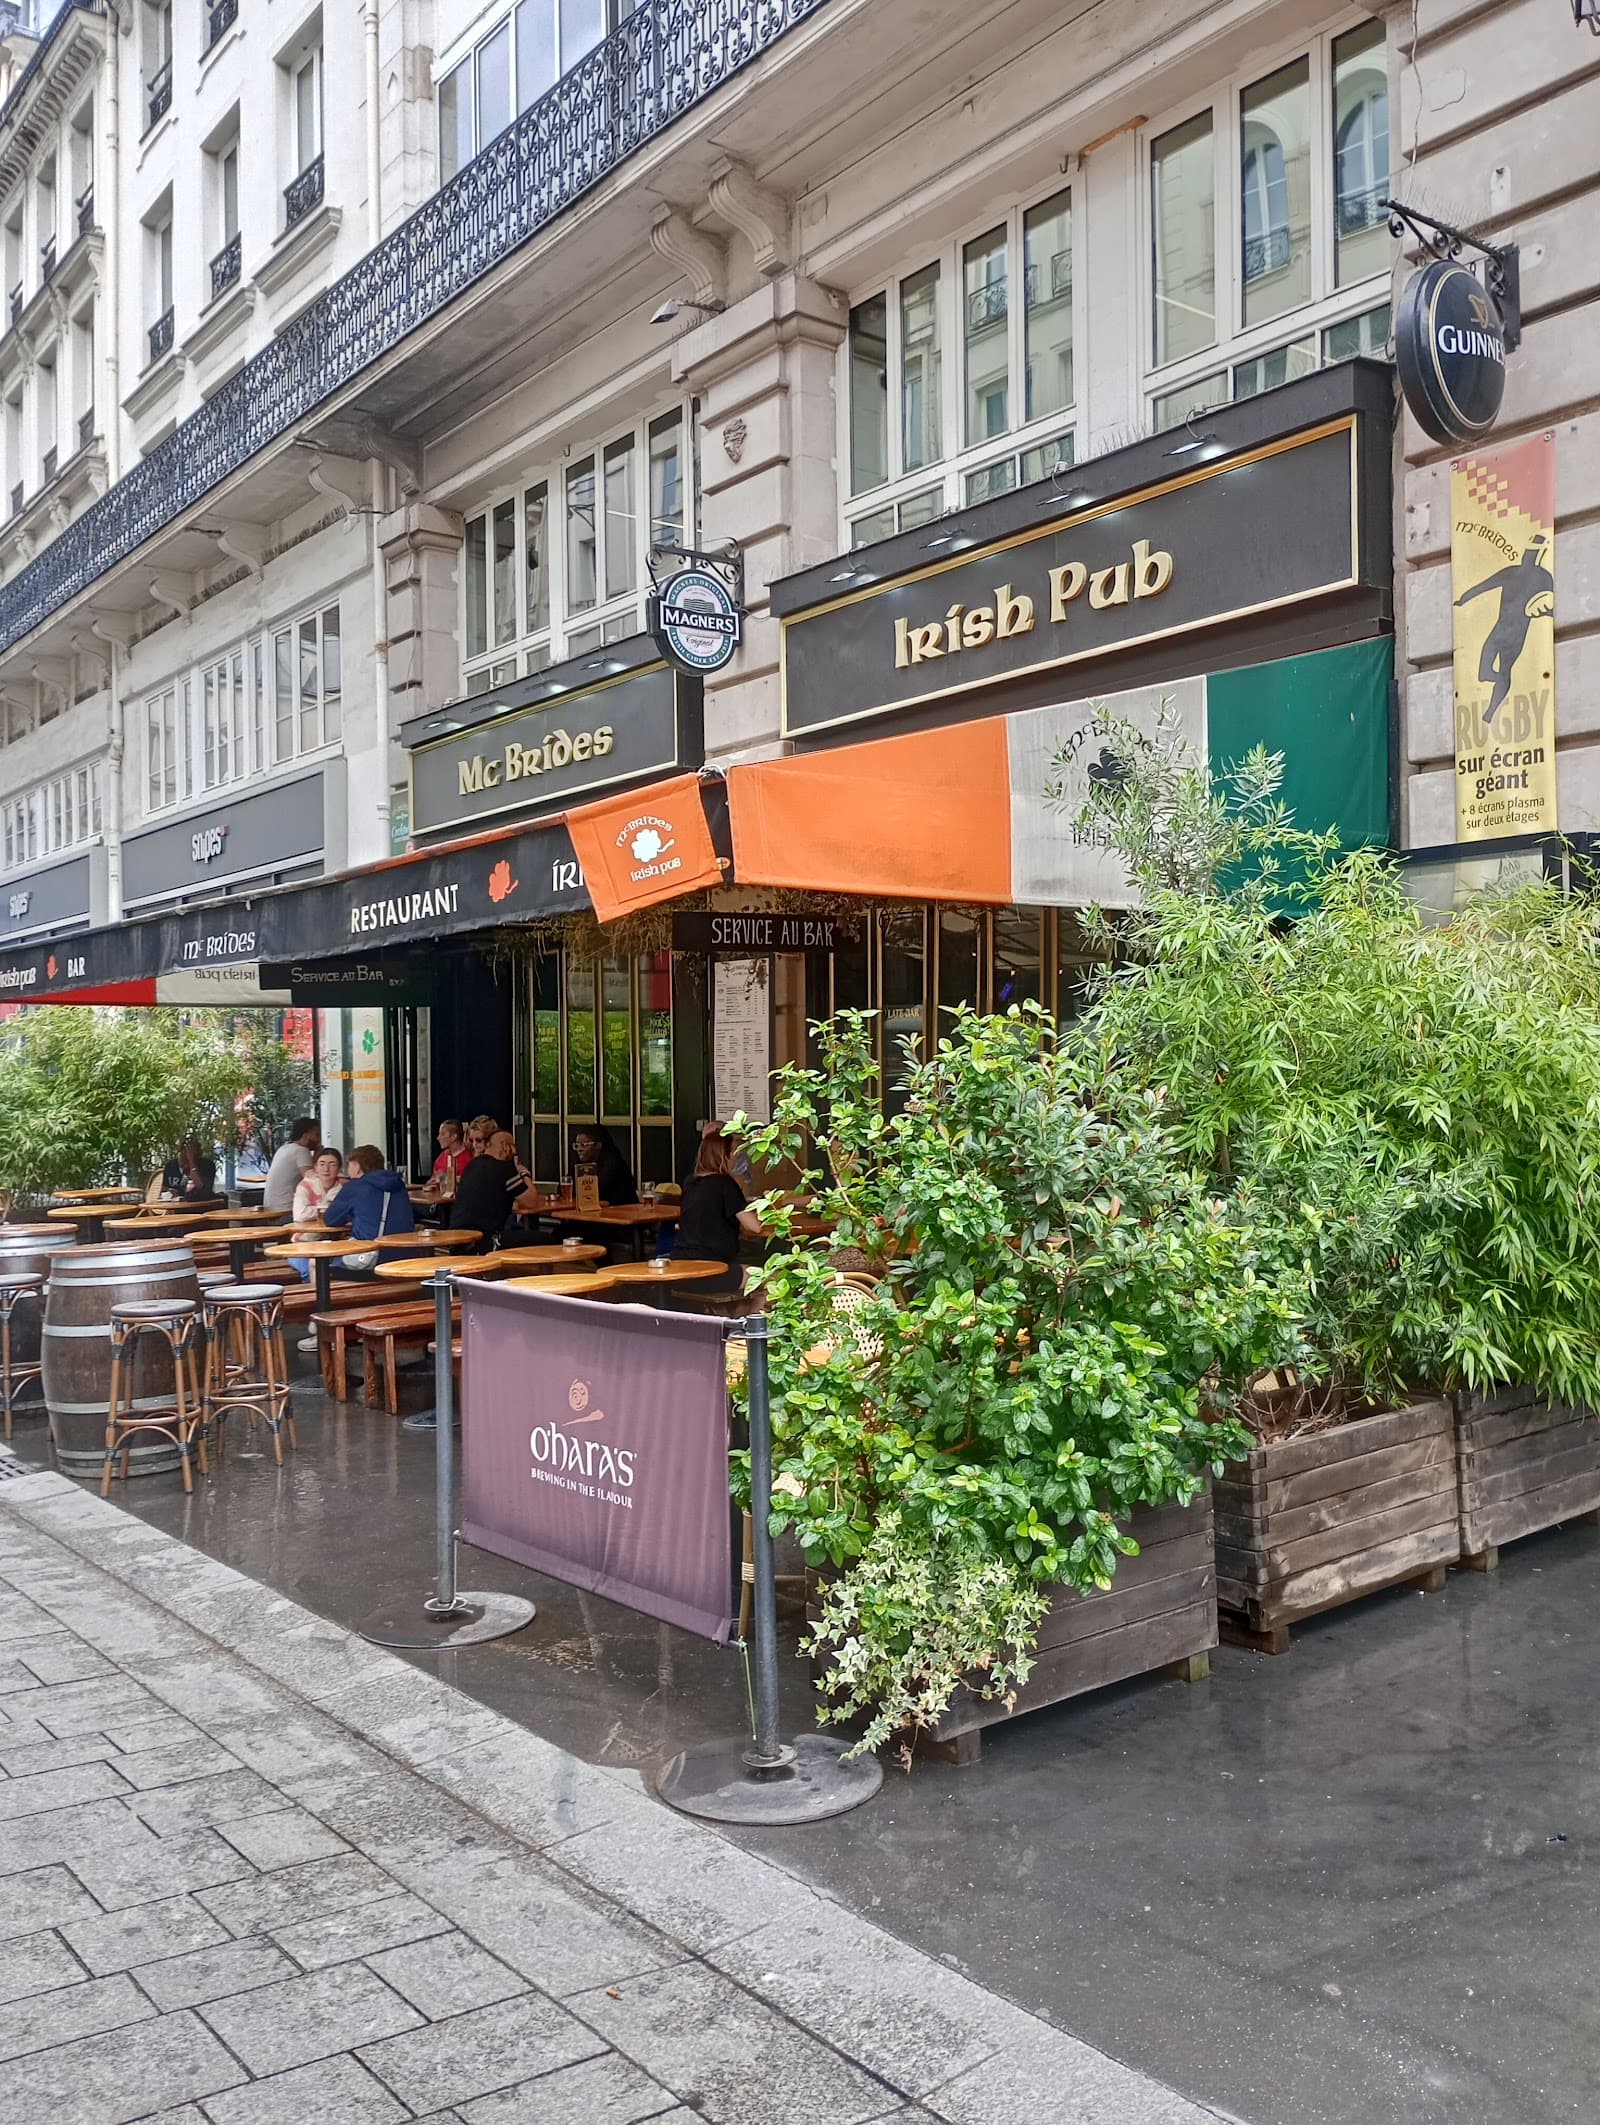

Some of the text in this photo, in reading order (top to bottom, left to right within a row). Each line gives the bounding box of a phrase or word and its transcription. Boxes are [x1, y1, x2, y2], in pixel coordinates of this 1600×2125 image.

[1437, 325, 1506, 366] GUINNE
[1047, 538, 1174, 623] Pub
[665, 609, 734, 633] MAGNERS
[1456, 689, 1549, 752] RUGBY
[457, 755, 502, 796] Mc
[1458, 747, 1545, 776] sur écran
[1475, 769, 1529, 800] géant
[1466, 811, 1540, 829] sur deux étages
[1469, 805, 1476, 815] 8
[1478, 799, 1505, 814] écrans
[1508, 796, 1545, 813] plasma
[351, 883, 459, 933] RESTAURANT
[711, 917, 835, 947] SERVICE AU BAR
[67, 956, 86, 978] BAR
[531, 1467, 566, 1488] BREWING
[566, 1479, 577, 1491] IN
[578, 1482, 596, 1497] THE
